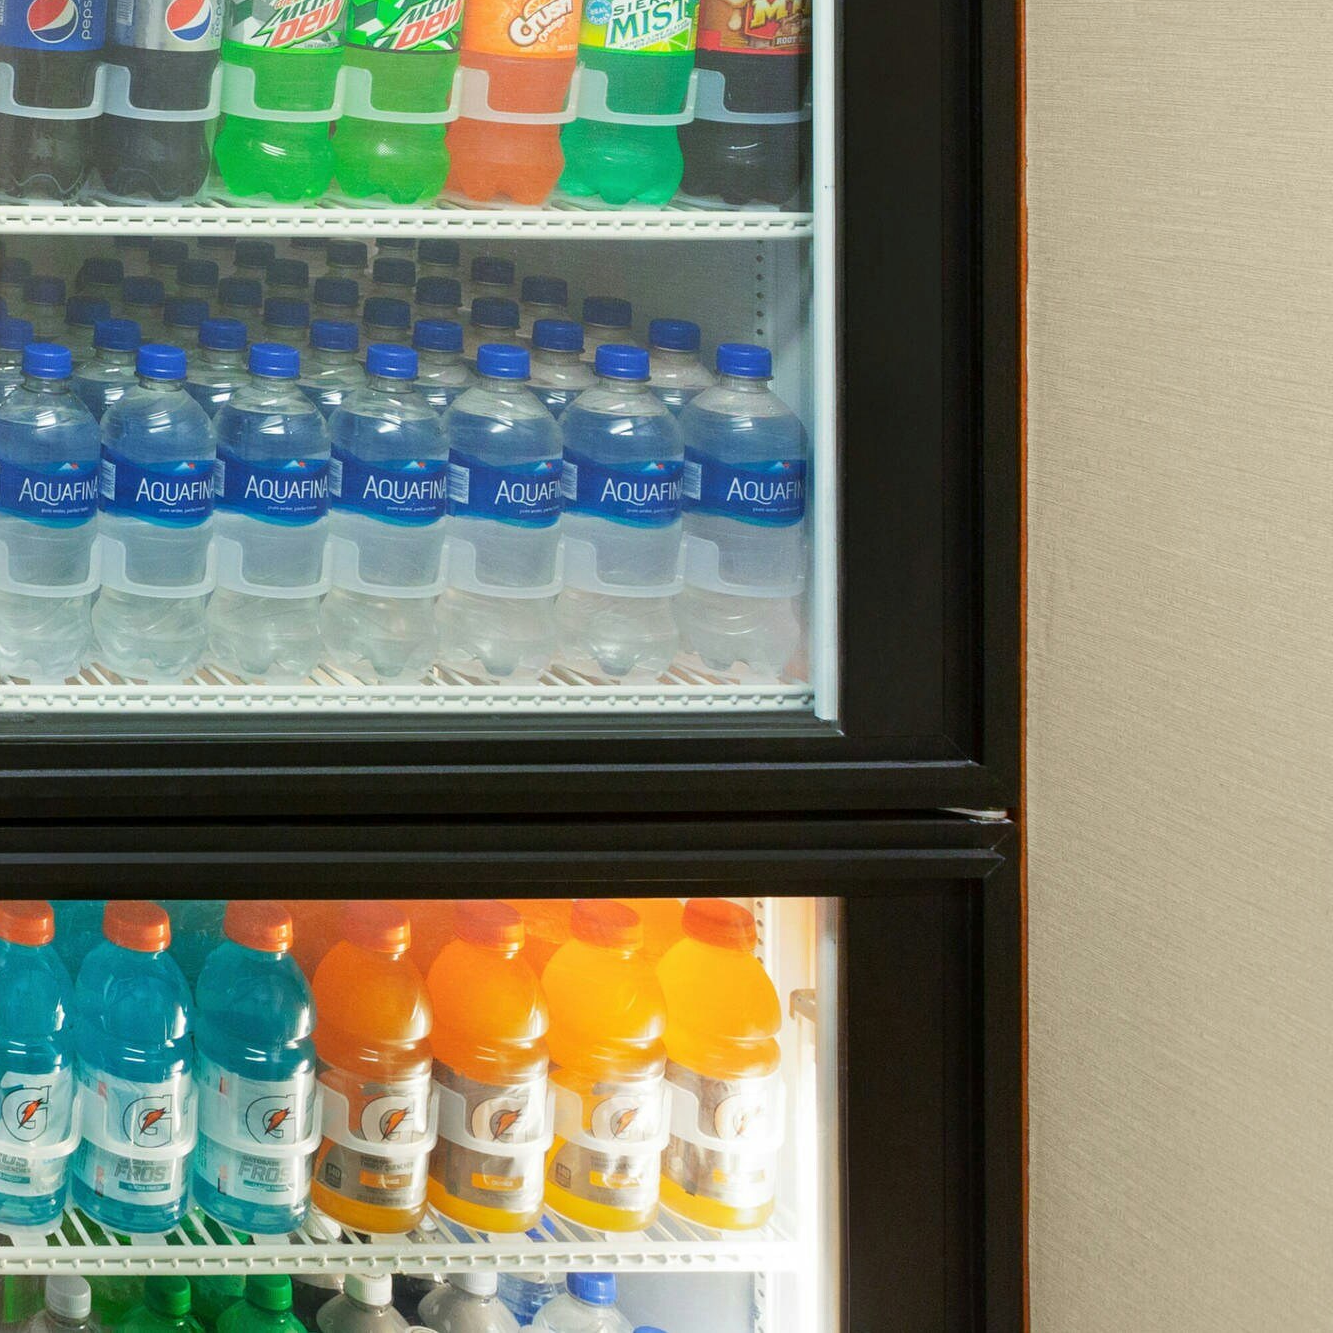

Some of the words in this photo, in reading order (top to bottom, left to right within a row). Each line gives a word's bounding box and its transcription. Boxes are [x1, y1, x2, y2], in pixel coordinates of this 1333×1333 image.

[776, 36, 797, 46] ROOT
[18, 477, 99, 506] AQUAFINA
[136, 477, 215, 506] AQUAFINA
[244, 474, 329, 504] AQUAFINA
[362, 474, 447, 506] AQUAFINA
